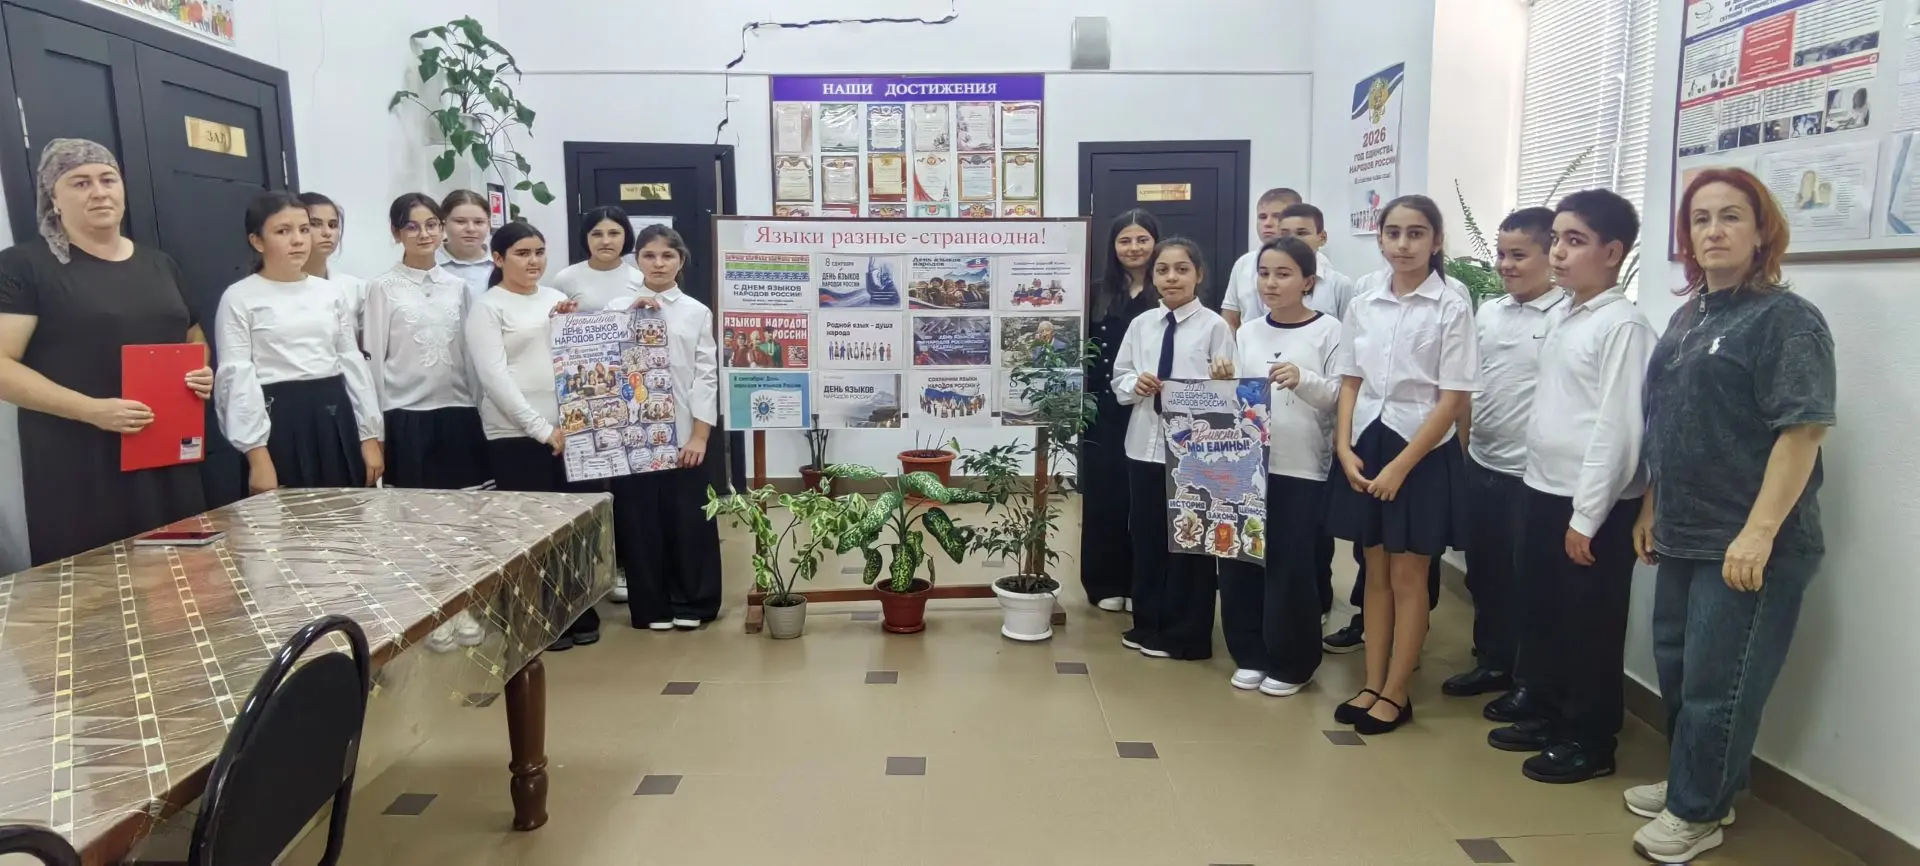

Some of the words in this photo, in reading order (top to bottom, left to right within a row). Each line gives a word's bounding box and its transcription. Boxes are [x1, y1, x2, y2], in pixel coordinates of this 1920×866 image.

[822, 83, 873, 95] НАШИ
[884, 82, 997, 97] ДОСТИЖЕНИЯ
[206, 129, 227, 146] ЗАЛ
[1363, 127, 1386, 148] 2026
[755, 226, 824, 244] Языки
[832, 230, 907, 248] разные
[825, 257, 831, 267] 8
[822, 272, 837, 281] ДЕНЬ
[837, 272, 860, 281] ЯЗЫКОВ
[741, 284, 765, 292] ДНЕМ
[767, 284, 802, 292] ЯЗЫКОВ
[733, 290, 769, 298] НАРОДОВ
[724, 316, 762, 328] ЯЗЫКОВ
[765, 317, 808, 329] НАРОДОВ
[826, 321, 852, 329] Родной
[875, 322, 893, 330] душа
[585, 323, 618, 333] ЯЗЫКОВ
[555, 334, 594, 345] НАРОДОВ
[596, 331, 628, 340] РОССИИ
[772, 329, 808, 340] РОССИИ
[824, 385, 844, 393] ДЕНЬ
[844, 386, 875, 394] ЯЗЫКОВ
[1185, 391, 1219, 400] ЕДИНСТВА
[1168, 399, 1199, 407] НАРОДОВ
[1199, 399, 1228, 408] РОССИИ
[1187, 442, 1205, 452] МЫ
[1206, 440, 1251, 452] ЕДИНЫ!
[1169, 501, 1206, 509] ИСТОРИЯ
[1207, 511, 1237, 521] ЗАКОНЫ
